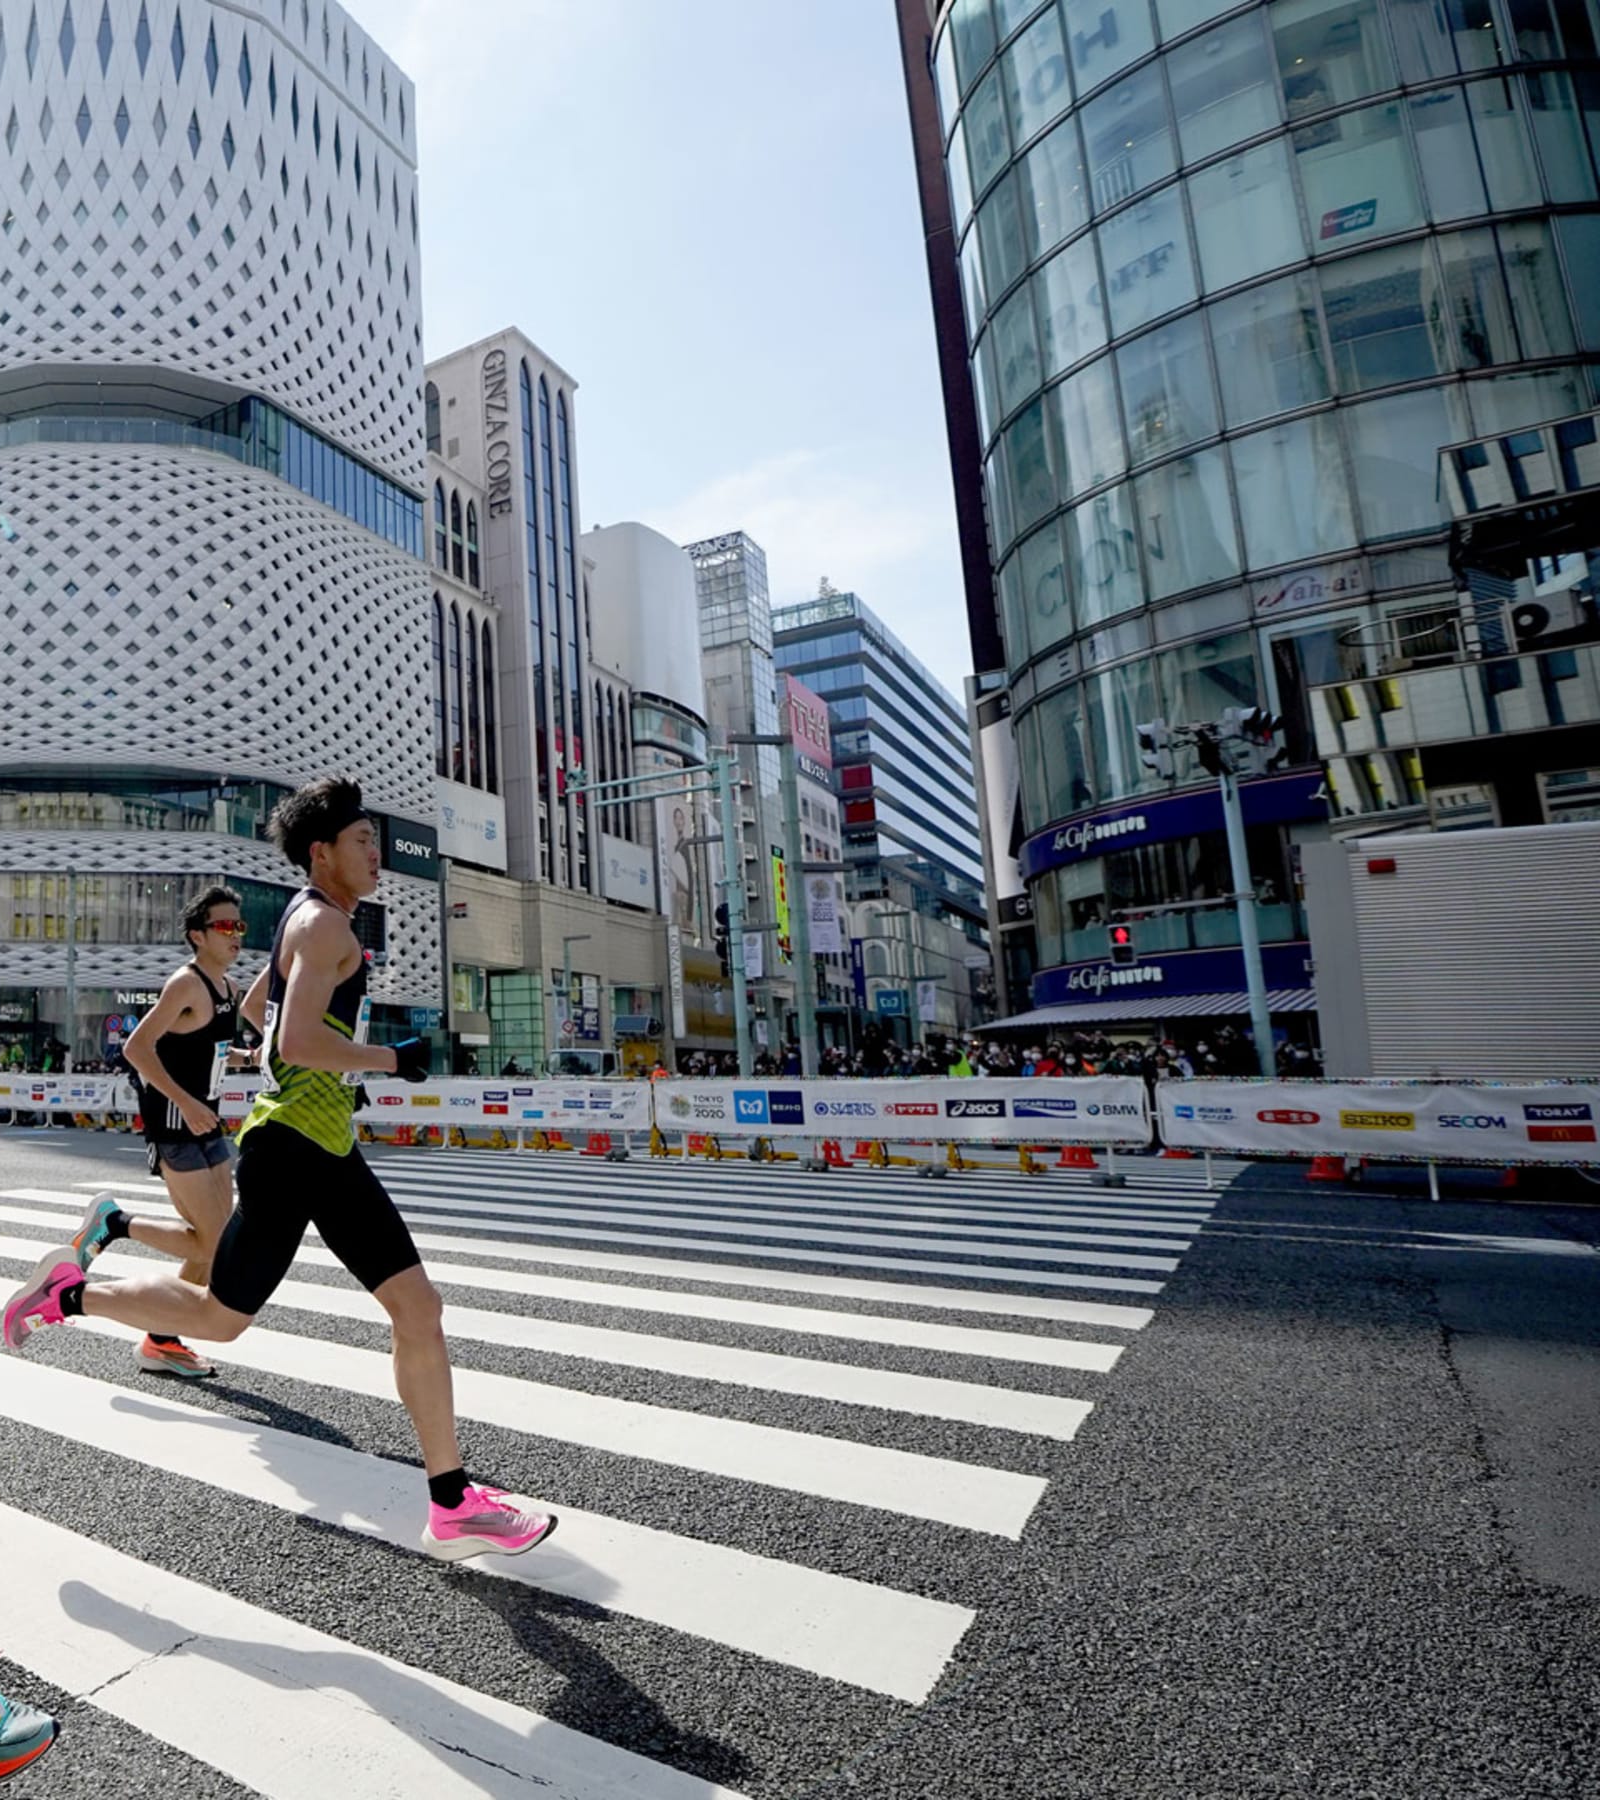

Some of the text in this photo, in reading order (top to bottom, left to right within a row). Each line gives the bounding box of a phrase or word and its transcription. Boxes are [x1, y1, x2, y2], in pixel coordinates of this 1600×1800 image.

[482, 349, 512, 519] GINZA CORE
[1065, 822, 1094, 852] Café
[395, 839, 431, 859] SONY
[1079, 964, 1109, 996] Café
[693, 1095, 724, 1104] TOKYO
[695, 1108, 725, 1119] 2020
[772, 1103, 800, 1112] 東京メトロ
[896, 1106, 937, 1115] ヤマザキ
[966, 1101, 1000, 1115] asics
[1103, 1104, 1138, 1116] BMW
[1344, 1113, 1411, 1128] SEIKO
[1438, 1115, 1506, 1129] SECOM
